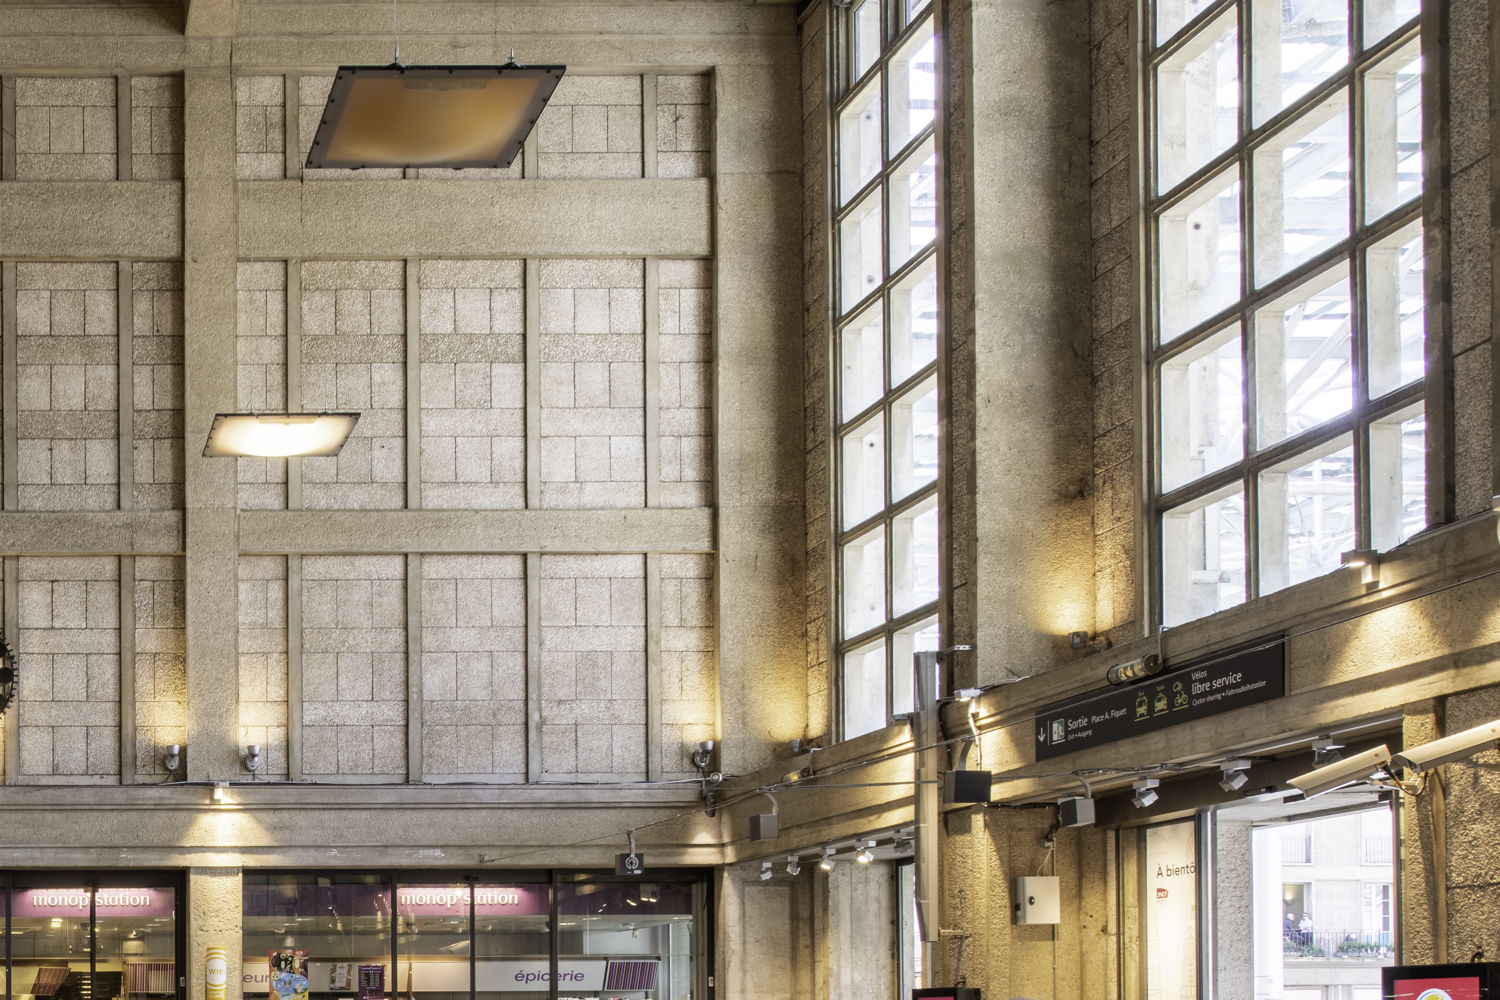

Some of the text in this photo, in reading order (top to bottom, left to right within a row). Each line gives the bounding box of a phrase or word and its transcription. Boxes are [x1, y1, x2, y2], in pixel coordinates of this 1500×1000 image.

[1191, 670, 1207, 680] Vélos
[1192, 672, 1242, 695] libre service
[1068, 716, 1088, 730] Sortie
[1091, 714, 1105, 723] Place
[1111, 708, 1127, 718] Fiquet
[1156, 862, 1196, 878] À bientô
[401, 890, 518, 909] monop'sation
